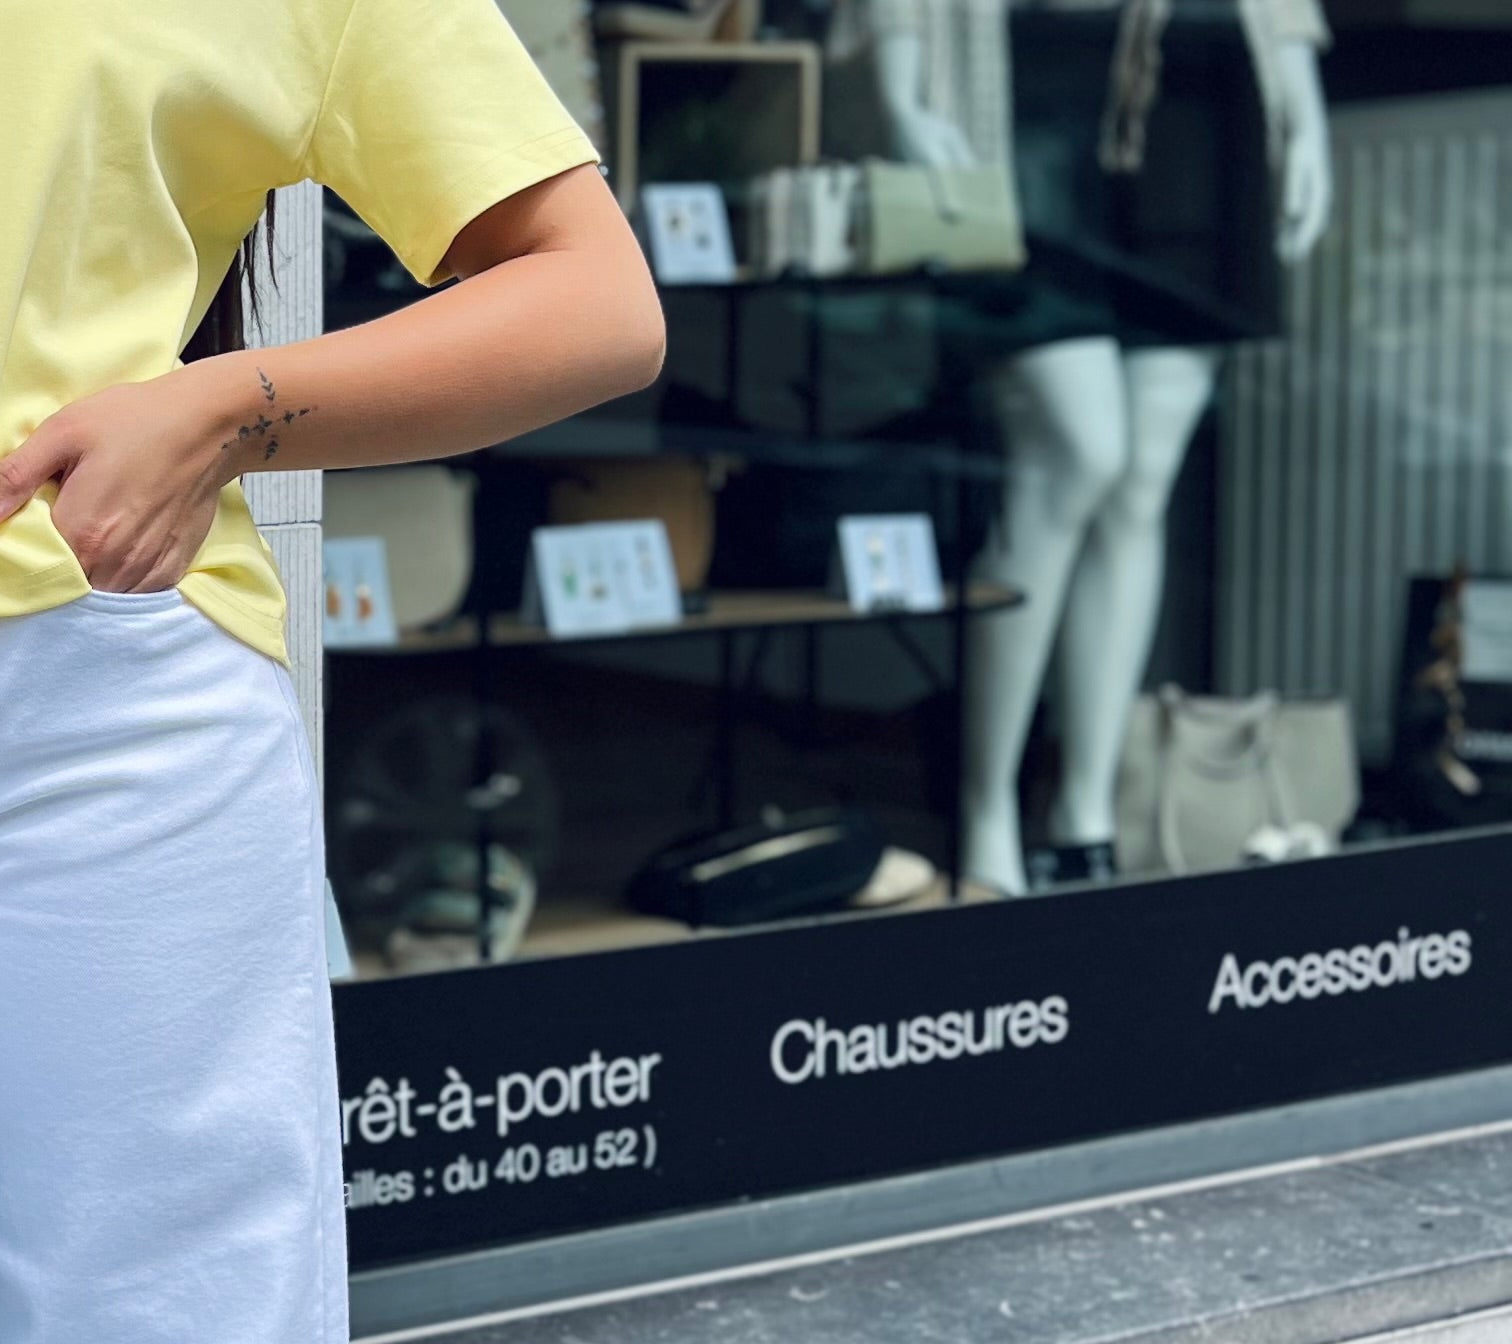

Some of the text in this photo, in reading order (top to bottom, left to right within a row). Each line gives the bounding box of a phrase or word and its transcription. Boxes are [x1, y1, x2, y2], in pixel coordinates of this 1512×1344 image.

[1207, 926, 1471, 1013] Accessoires
[770, 995, 1068, 1083] Chaussures
[341, 1050, 662, 1145] rêt-à-porter
[343, 1168, 415, 1209] ailles
[442, 1155, 488, 1194] du
[494, 1144, 540, 1183] 40
[545, 1143, 588, 1178] au
